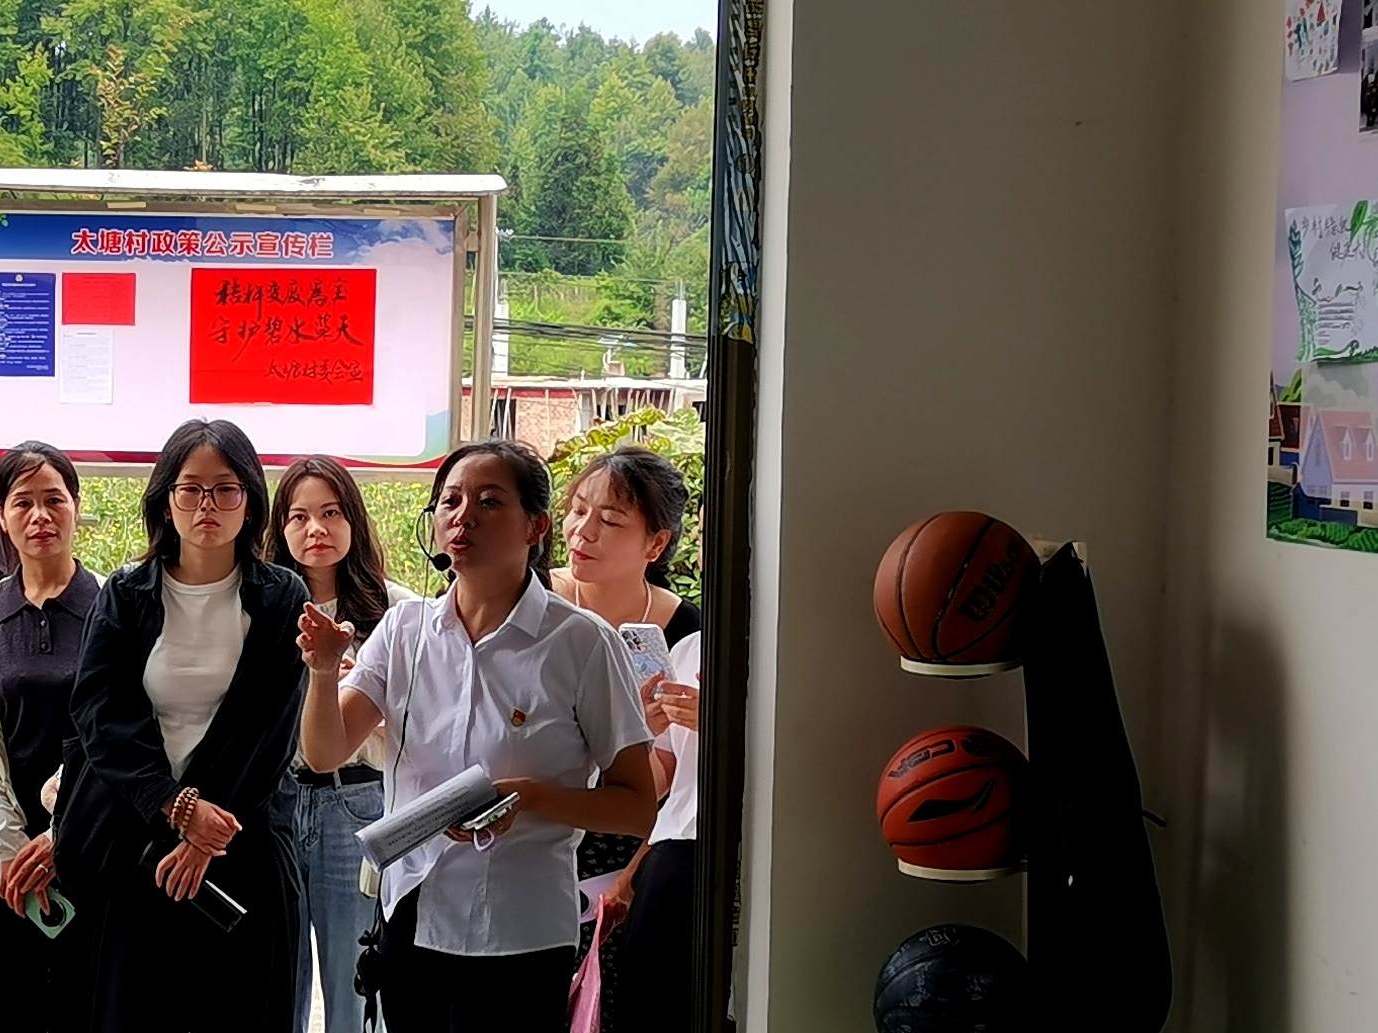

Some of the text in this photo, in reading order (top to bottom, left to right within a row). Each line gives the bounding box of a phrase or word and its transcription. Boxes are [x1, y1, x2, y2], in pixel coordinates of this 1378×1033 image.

[71, 228, 335, 259] 太塘村政策公示宣传栏
